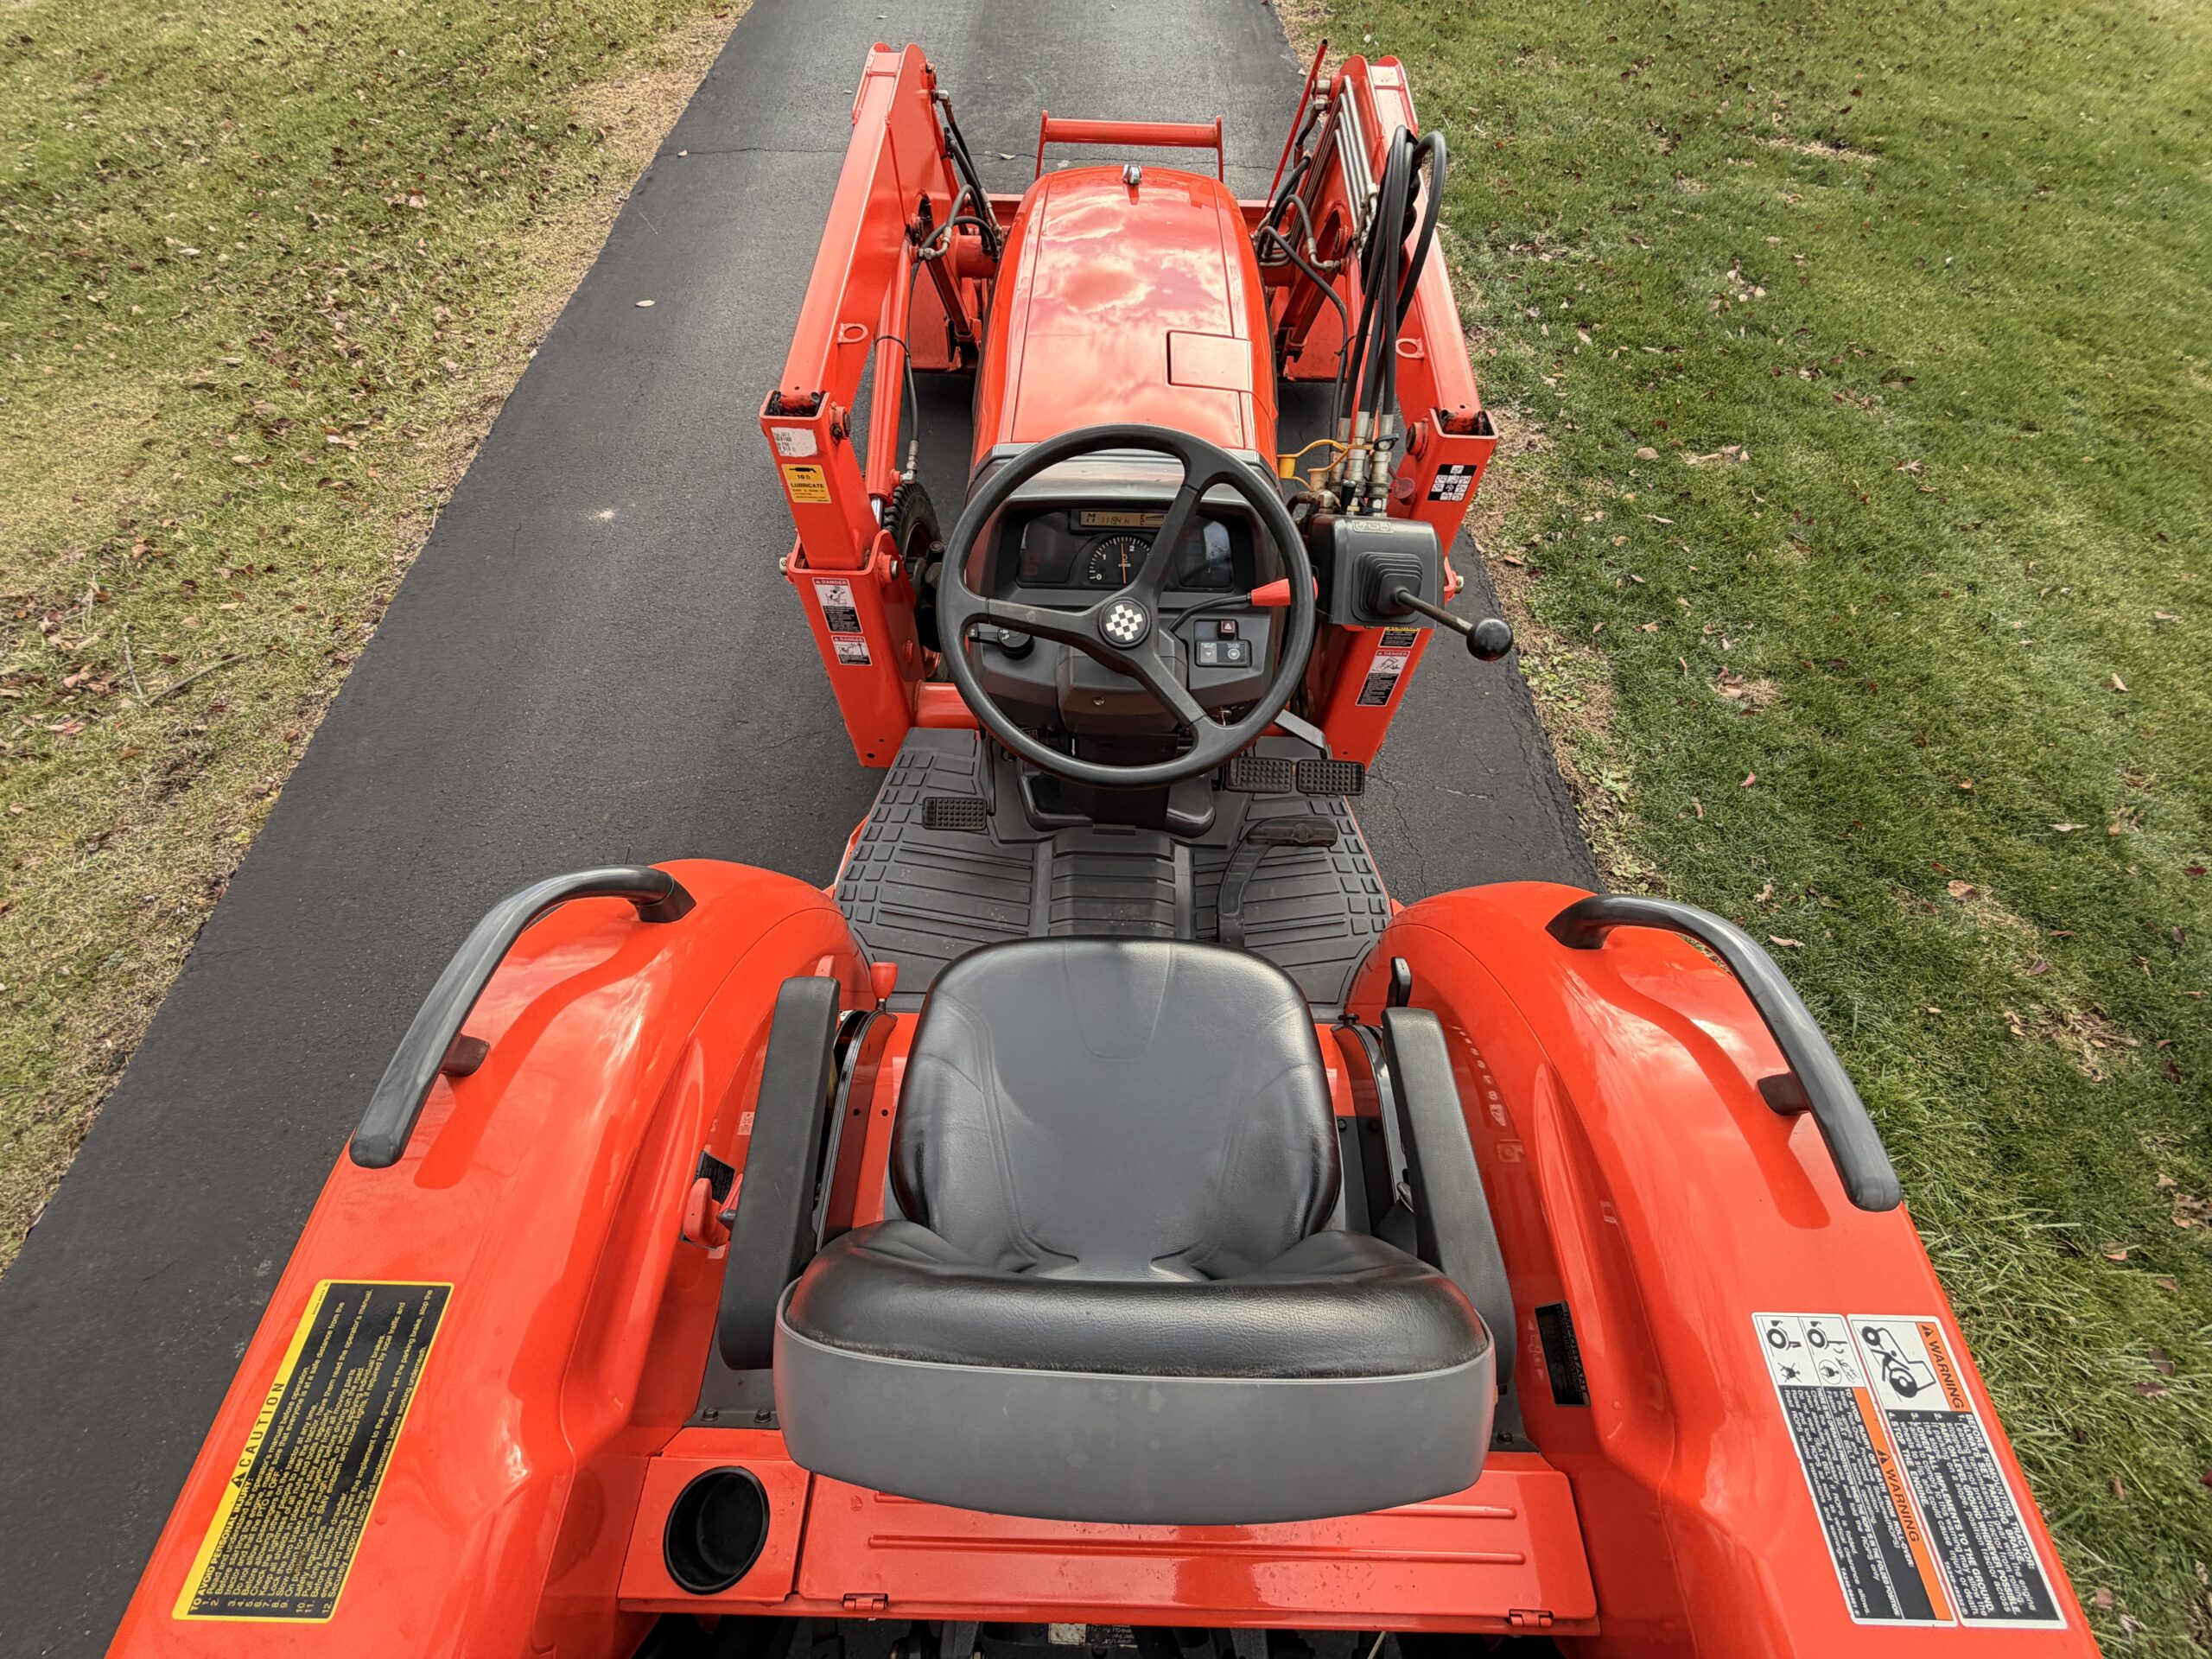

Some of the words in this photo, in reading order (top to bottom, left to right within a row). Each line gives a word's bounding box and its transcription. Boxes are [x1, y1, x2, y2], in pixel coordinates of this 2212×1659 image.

[1488, 1090, 1498, 1101] 8
[1927, 1340, 1965, 1408] WARNING
[395, 1386, 413, 1414] working
[1843, 1388, 1853, 1397] TO
[1847, 1400, 1861, 1421] AVOID
[238, 1382, 285, 1467] CAUTION
[299, 1421, 312, 1435] any
[386, 1415, 401, 1439] before
[1838, 1390, 1850, 1408] Keep
[1846, 1411, 1863, 1443] Roll-Over
[1858, 1446, 1877, 1482] Protective
[1904, 1421, 1923, 1448] Failure
[1913, 1421, 1933, 1452] LOWER
[1922, 1421, 1934, 1434] the
[1936, 1422, 1953, 1444] PARK
[1825, 1390, 1839, 1413] Fasten
[1834, 1416, 1847, 1436] SEAT
[1842, 1440, 1855, 1459] BELT
[1850, 1462, 1865, 1485] before
[1857, 1424, 1872, 1450] INJURY
[1927, 1437, 1944, 1461] slope.
[1944, 1421, 1965, 1454] stopped
[1951, 1422, 1973, 1453] Leaving
[284, 1446, 301, 1469] tractor
[370, 1440, 393, 1483] implements
[1834, 1400, 1845, 1411] the
[1840, 1414, 1853, 1438] upright
[1849, 1440, 1859, 1454] and
[1855, 1458, 1870, 1481] locked
[1864, 1484, 1880, 1513] position
[1866, 1452, 1877, 1464] OR
[1916, 1450, 1927, 1459] to
[1926, 1453, 1940, 1470] ALL
[1946, 1445, 1958, 1457] ON
[1959, 1455, 1972, 1470] will
[1890, 1421, 1906, 1445] STOP
[1900, 1448, 1914, 1466] THE
[1909, 1470, 1929, 1507] ENGINE.
[1919, 1459, 1939, 1489] comply
[1951, 1459, 1968, 1483] LEVEL
[274, 1484, 284, 1495] on
[278, 1471, 290, 1484] the
[1872, 1466, 1887, 1492] DEATH
[1965, 1471, 1978, 1484] not
[1965, 1455, 1995, 1508] transmission
[205, 1571, 224, 1594] Read
[216, 1554, 230, 1570] and
[223, 1507, 250, 1552] understand
[244, 1493, 256, 1506] the
[250, 1453, 273, 1491] operator's
[266, 1425, 285, 1452] manual
[278, 1401, 296, 1424] before
[232, 1478, 253, 1512] INJURY:
[363, 1484, 376, 1499] and
[1898, 1421, 1916, 1449] wheels
[1910, 1450, 1920, 1459] to
[1920, 1478, 1934, 1494] and
[1927, 1495, 1943, 1518] could
[1936, 1520, 1953, 1546] cause
[1947, 1550, 1965, 1575] injury
[1958, 1576, 1968, 1586] or
[1931, 1491, 1943, 1499] to
[1933, 1471, 1963, 1530] IMPLEMENTS
[1960, 1422, 1982, 1458] ALWAYS
[1976, 1462, 1991, 1479] SET
[1985, 1484, 2010, 1524] PARKING
[2004, 1529, 2026, 1564] BRAKE.
[1961, 1484, 1983, 1519] GROUND
[1964, 1414, 1986, 1448] BEFORE
[1980, 1452, 2014, 1516] DISMOUNTING
[2009, 1521, 2036, 1569] TRACTOR:
[1970, 1486, 1992, 1518] prevent
[353, 1501, 370, 1526] tractor
[1882, 1495, 1897, 1517] FROM
[1884, 1468, 1921, 1541] WARNING
[1936, 1501, 1950, 1516] this
[254, 1497, 281, 1543] passengers
[1931, 1429, 1951, 1460] parking
[1945, 1461, 1955, 1472] on
[1952, 1483, 1970, 1508] slope,
[1963, 1510, 1985, 1546] position
[1980, 1548, 1998, 1579] tractor
[1992, 1580, 2012, 1611] across
[1992, 1520, 2009, 1540] gear
[209, 1514, 238, 1564] PERSONAL
[323, 1526, 335, 1539] the
[341, 1528, 361, 1560] support
[1942, 1518, 1963, 1552] warning
[1956, 1532, 1969, 1545] TO
[1976, 1521, 2002, 1567] WHENEVER
[1985, 1520, 2004, 1549] tractor
[243, 1543, 260, 1566] allow
[315, 1541, 329, 1560] from
[1962, 1547, 1977, 1566] THE
[1998, 1551, 2013, 1572] from
[2000, 1541, 2017, 1560] with
[238, 1567, 251, 1580] not
[308, 1560, 323, 1580] only
[1955, 1554, 1971, 1573] may
[2010, 1562, 2024, 1577] the
[195, 1565, 216, 1595] AVOID
[231, 1581, 245, 1595] Do
[301, 1580, 316, 1597] Pull
[327, 1560, 349, 1598] Securely
[1964, 1575, 1982, 1599] allow
[1969, 1567, 1995, 1612] GROUND.
[2005, 1574, 2027, 1605] rolling.
[226, 1598, 238, 1606] 3.
[1995, 1569, 2021, 1614] POSSIBLE.
[2016, 1579, 2037, 1611] engine
[189, 1597, 203, 1611] TO
[295, 1599, 307, 1612] 10.
[321, 1600, 334, 1613] 12.
[1974, 1601, 1988, 1616] the
